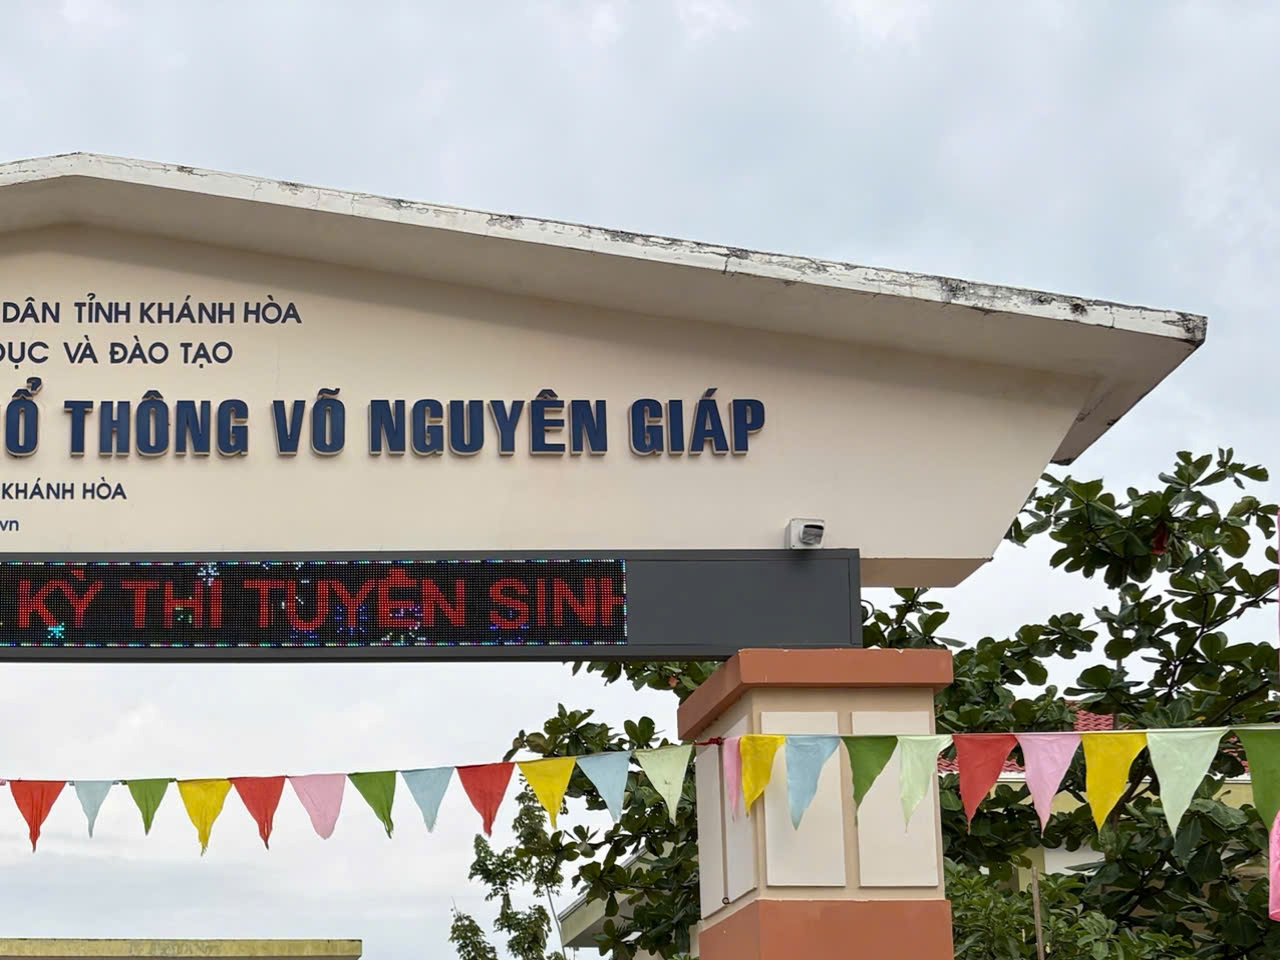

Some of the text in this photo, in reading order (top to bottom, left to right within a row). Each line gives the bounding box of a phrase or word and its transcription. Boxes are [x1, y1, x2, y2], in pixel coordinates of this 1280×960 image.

[2, 296, 61, 324] DÂN
[73, 292, 131, 324] TỈNH
[139, 294, 235, 324] KHÁNH
[243, 292, 303, 325] HÒA
[63, 334, 99, 364] VÀ
[109, 334, 169, 365] ĐÀO
[179, 341, 233, 369] TẠO
[62, 388, 249, 455] THÔNG
[271, 386, 346, 454] VÕ
[369, 388, 609, 454] NGUYÊN
[629, 387, 766, 454] GIÁP
[1, 477, 75, 500] KHÁNH
[82, 476, 127, 500] HÒA
[18, 569, 101, 627] KỲ
[121, 580, 223, 626] THI
